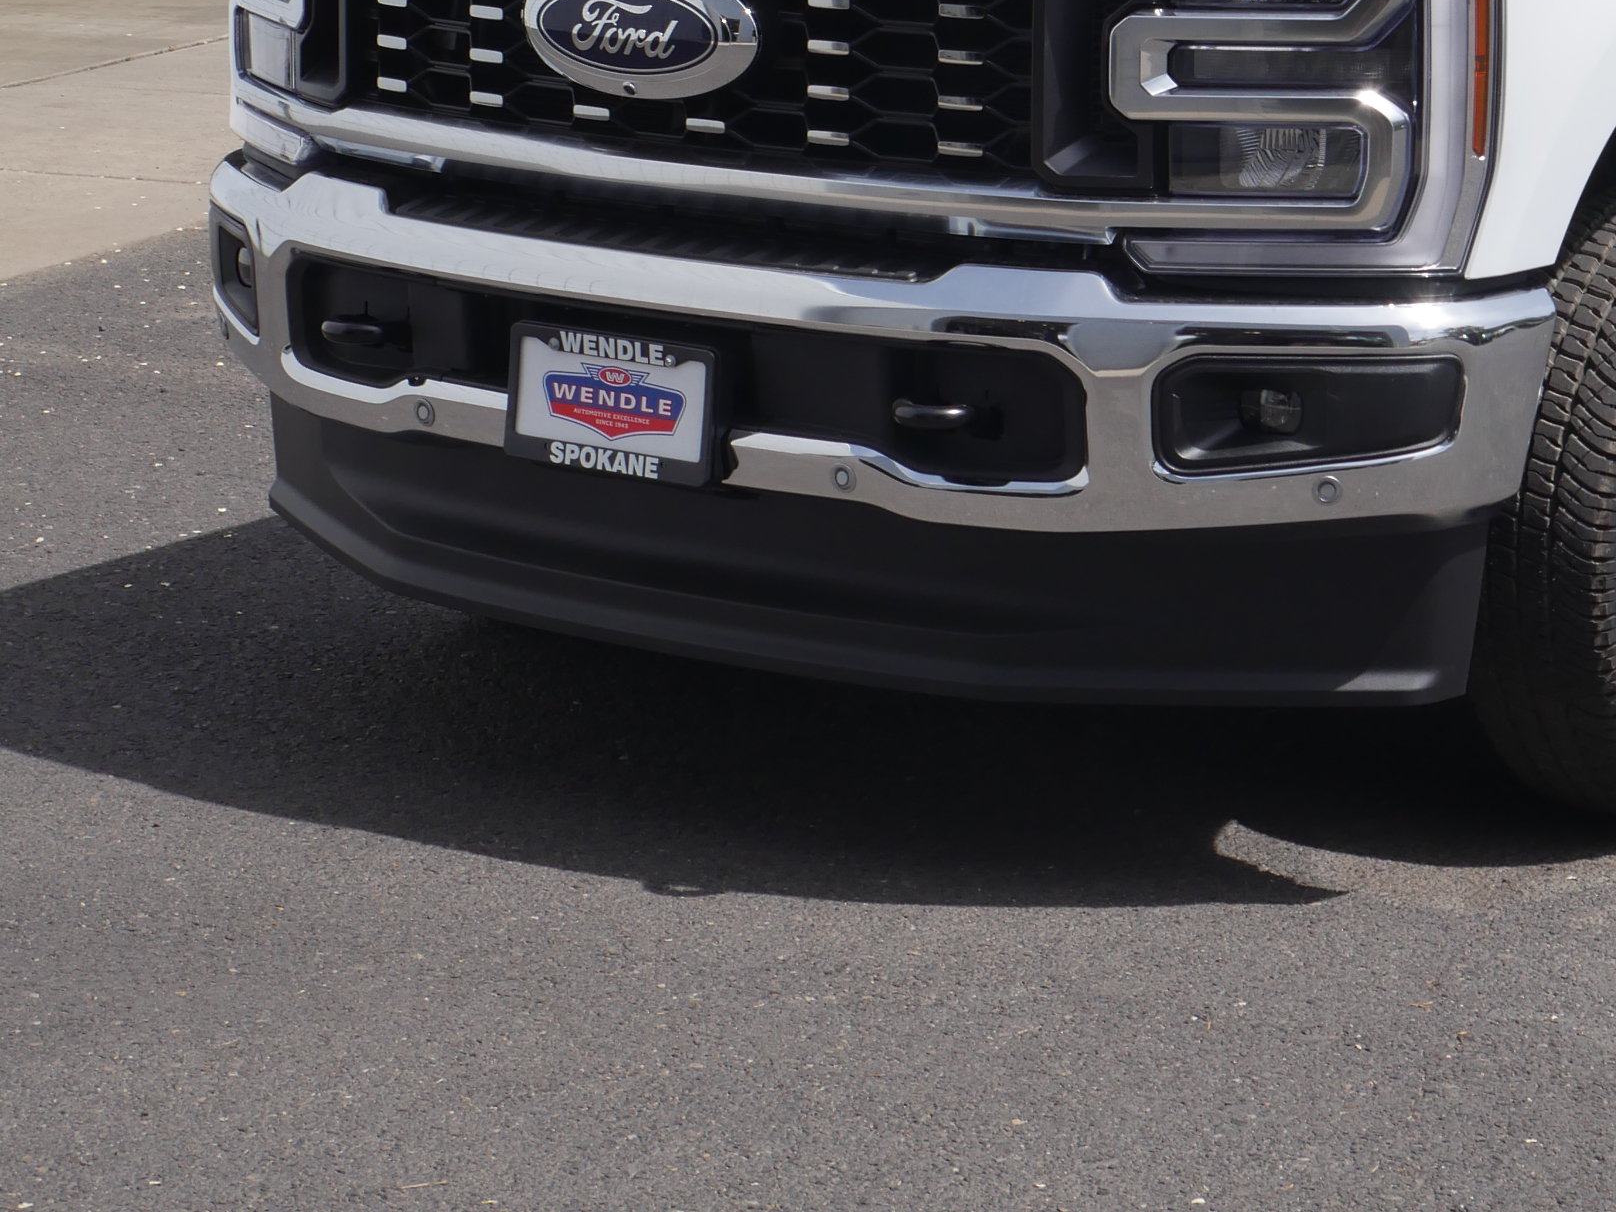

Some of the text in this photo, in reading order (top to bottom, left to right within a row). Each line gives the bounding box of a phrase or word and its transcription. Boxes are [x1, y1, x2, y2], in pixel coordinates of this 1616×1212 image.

[560, 331, 665, 366] WENDLE
[553, 382, 673, 417] WENDLE
[573, 408, 650, 425] AUTOMOTIVE EXCELLENCE
[595, 418, 613, 426] SINCE
[549, 441, 660, 479] SPOKANE
